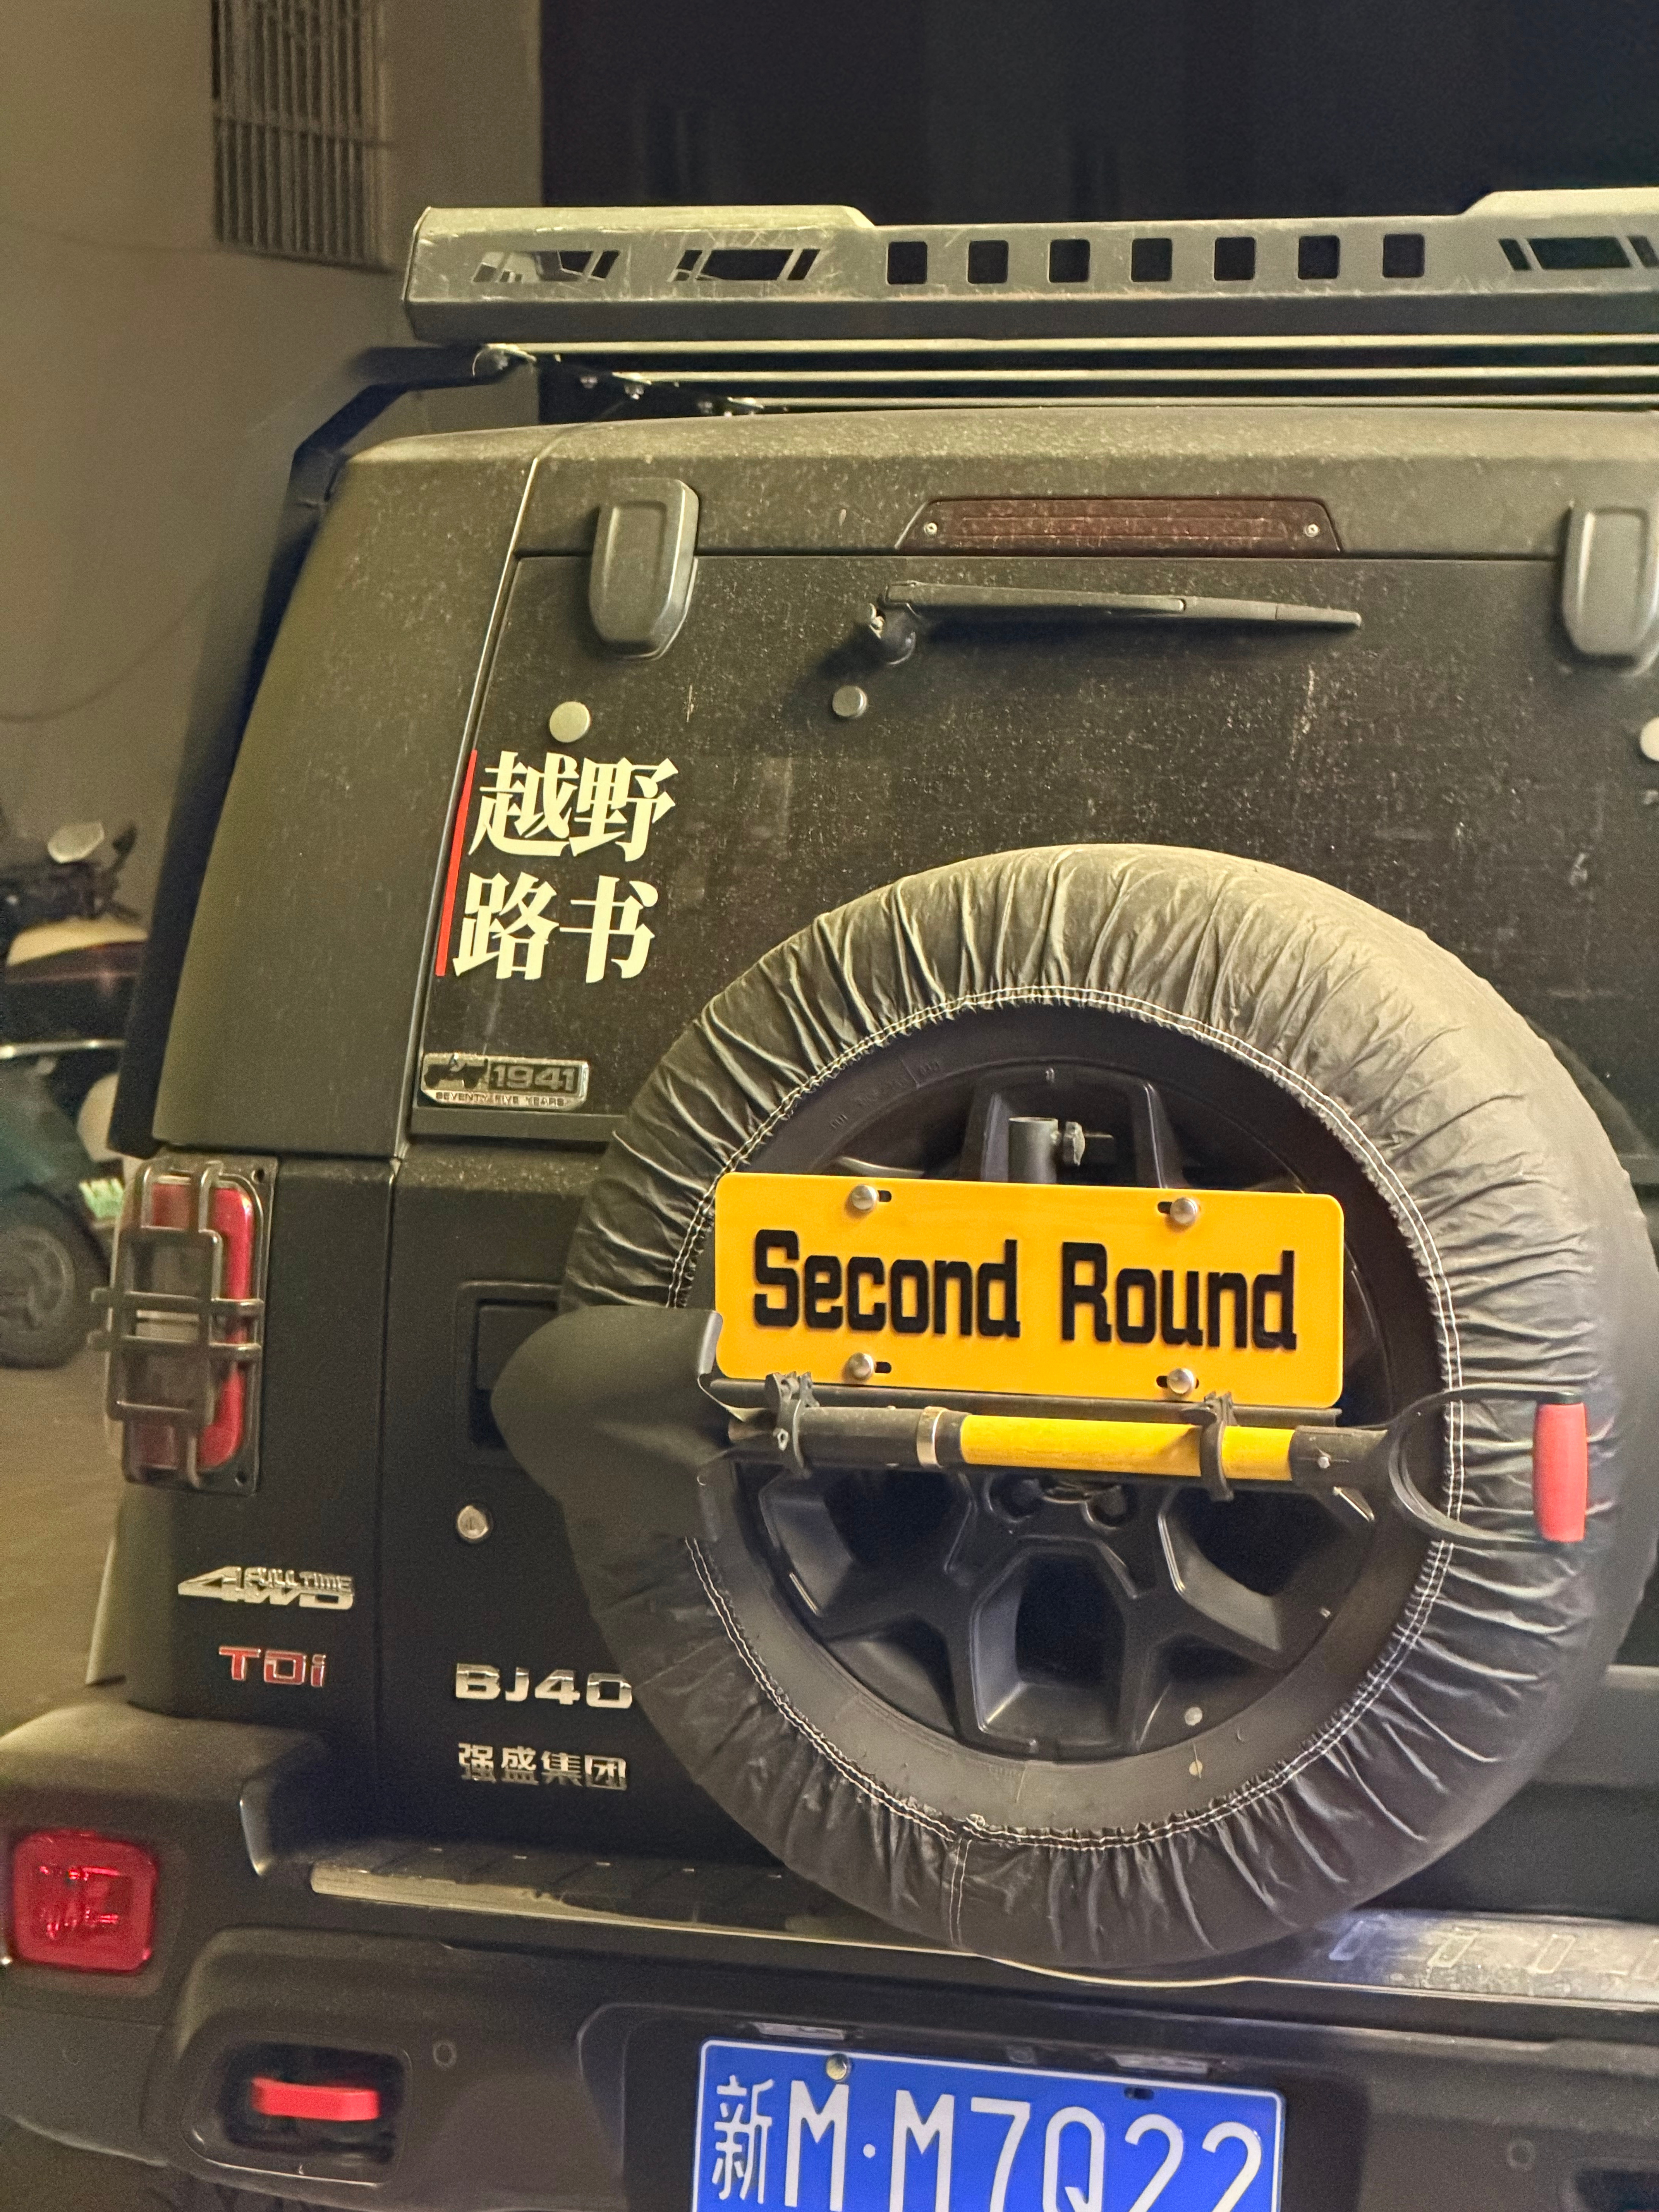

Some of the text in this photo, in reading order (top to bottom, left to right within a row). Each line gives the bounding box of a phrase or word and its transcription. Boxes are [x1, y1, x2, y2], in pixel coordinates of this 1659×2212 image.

[469, 750, 678, 862] 越野
[452, 872, 659, 983] 路书
[493, 1065, 575, 1091] 1941
[754, 1229, 1297, 1350] Second Round
[455, 1663, 632, 1709] BJ40
[458, 1743, 628, 1791] 强盛集团
